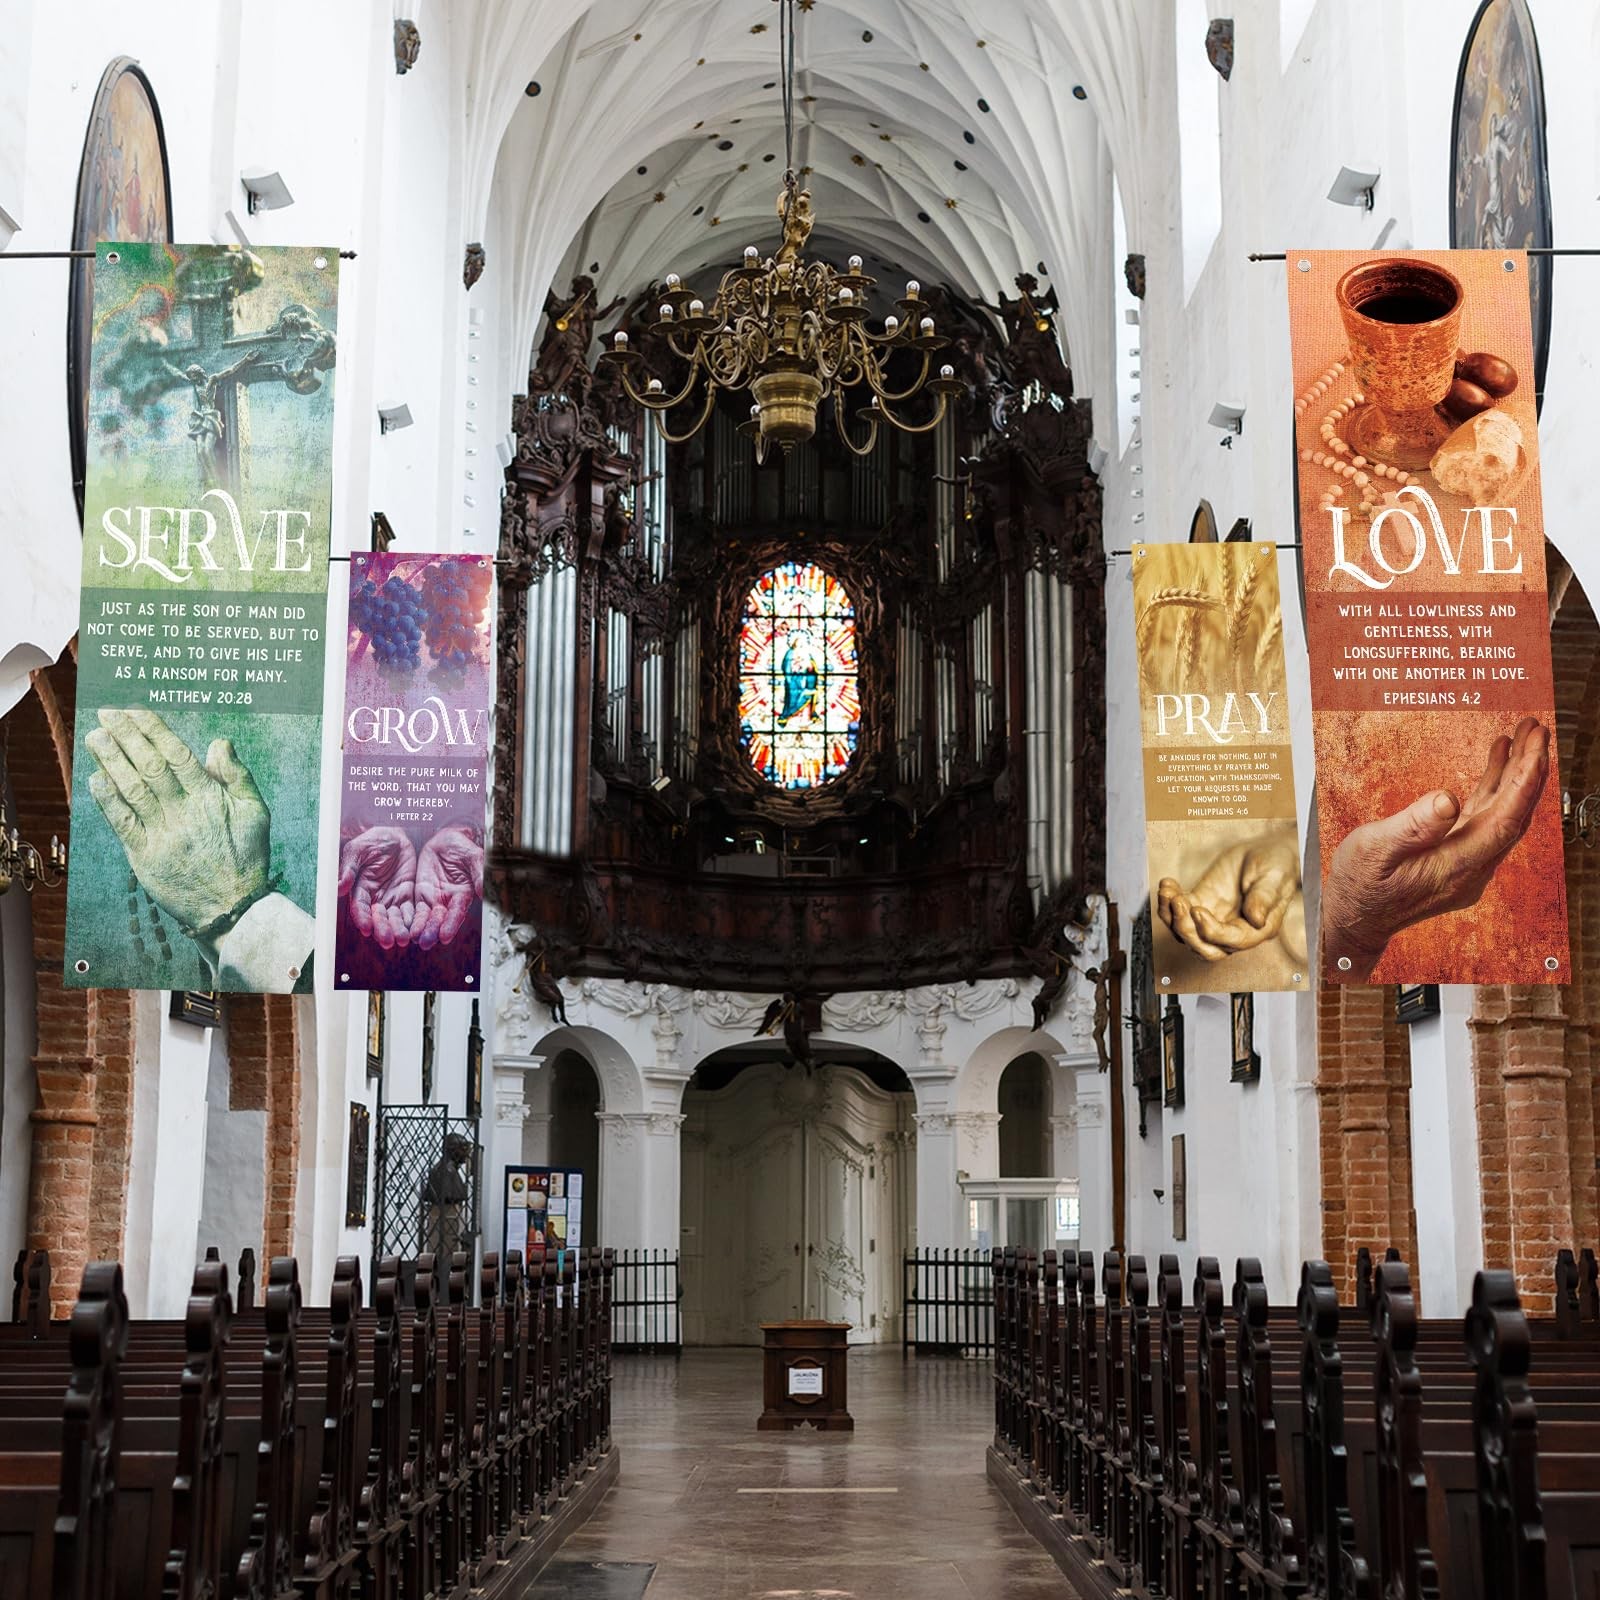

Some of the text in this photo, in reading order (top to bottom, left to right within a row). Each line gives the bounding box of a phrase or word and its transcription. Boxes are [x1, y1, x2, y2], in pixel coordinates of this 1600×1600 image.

[99, 488, 312, 583] SERVE
[1326, 486, 1522, 589] LOVE
[100, 602, 305, 619] JUST AS THE SON OF MAN DID
[1339, 605, 1516, 617] WITH ALL LOWLINESS AND
[87, 624, 112, 635] NOT
[120, 624, 155, 636] COME
[162, 625, 178, 637] TO
[185, 626, 201, 637] BE
[270, 629, 295, 640] BUT
[302, 629, 318, 640] TO
[1365, 626, 1492, 639] GENTLENESS, WITH
[101, 644, 302, 662] SERVE, AND TO GIVE HIS LIFE
[1344, 647, 1515, 660] LONGSUFFERING, BEARING
[115, 667, 287, 683] AS A RANSOM FOR MANY.
[1333, 668, 1529, 680] WITH ONE ANOTHER IN LOVE.
[150, 690, 252, 704] MATTHEW 20:28
[1384, 692, 1481, 704] EPHESIANS 4:2
[348, 696, 485, 752] GROW
[1154, 692, 1278, 744] PRAY
[350, 767, 383, 776] DESIRE
[388, 767, 406, 776] THE
[411, 768, 435, 776] PURE
[467, 769, 478, 777] OF
[348, 782, 366, 791] THE
[407, 783, 431, 792] THAT
[436, 784, 455, 792] YOU
[460, 784, 480, 792] MAY
[1205, 785, 1240, 793] REQUESTS
[375, 797, 452, 808] GROW THEREBY.
